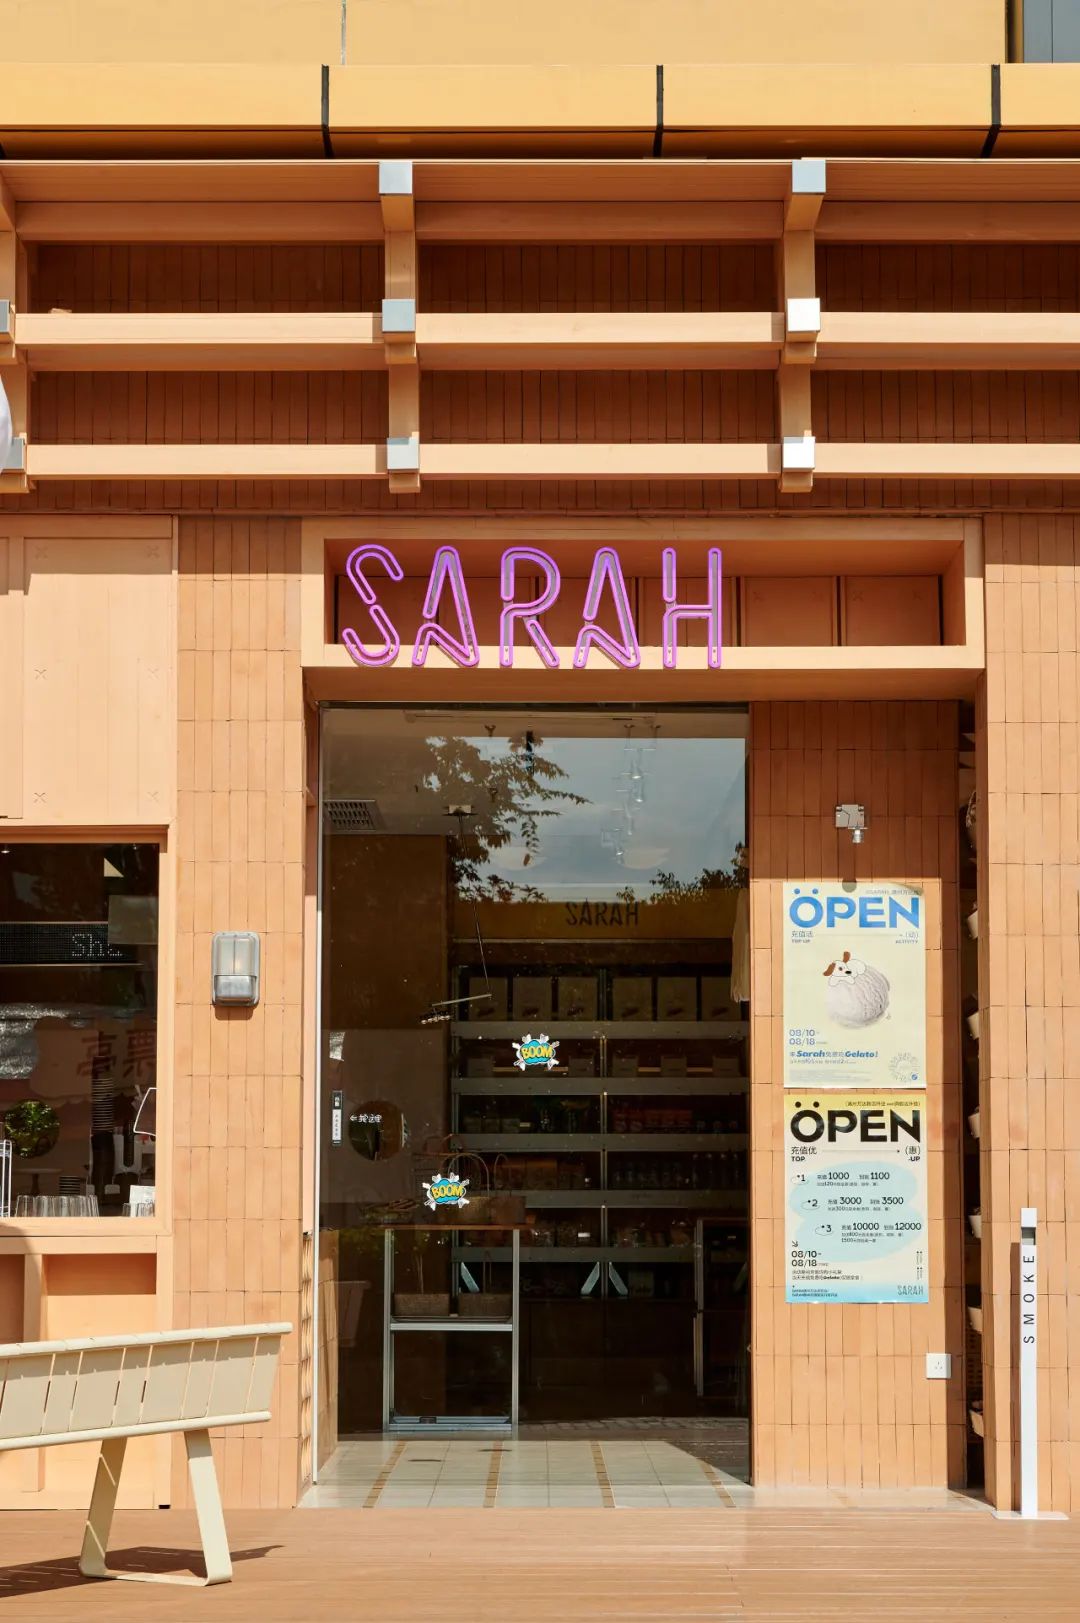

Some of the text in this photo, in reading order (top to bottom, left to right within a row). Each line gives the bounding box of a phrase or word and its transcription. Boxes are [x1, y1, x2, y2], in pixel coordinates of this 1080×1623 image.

[342, 544, 722, 668] SARAH
[565, 901, 639, 926] SARAH
[789, 888, 920, 928] ÖPEN
[789, 1038, 815, 1046] 08/18
[520, 1045, 553, 1060] BOOM
[790, 1101, 921, 1143] ÖPEN
[791, 1146, 818, 1156] 充值优
[828, 1172, 850, 1180] 1000
[870, 1172, 890, 1180] 1100
[431, 1184, 464, 1200] BOOM
[839, 1197, 862, 1205] 3000
[882, 1197, 904, 1205] 3500
[852, 1222, 880, 1231] 10000
[895, 1222, 922, 1231] 12000
[791, 1259, 818, 1268] 08/18
[897, 1285, 924, 1296] SARAH
[1023, 1255, 1035, 1344] SMOKE
